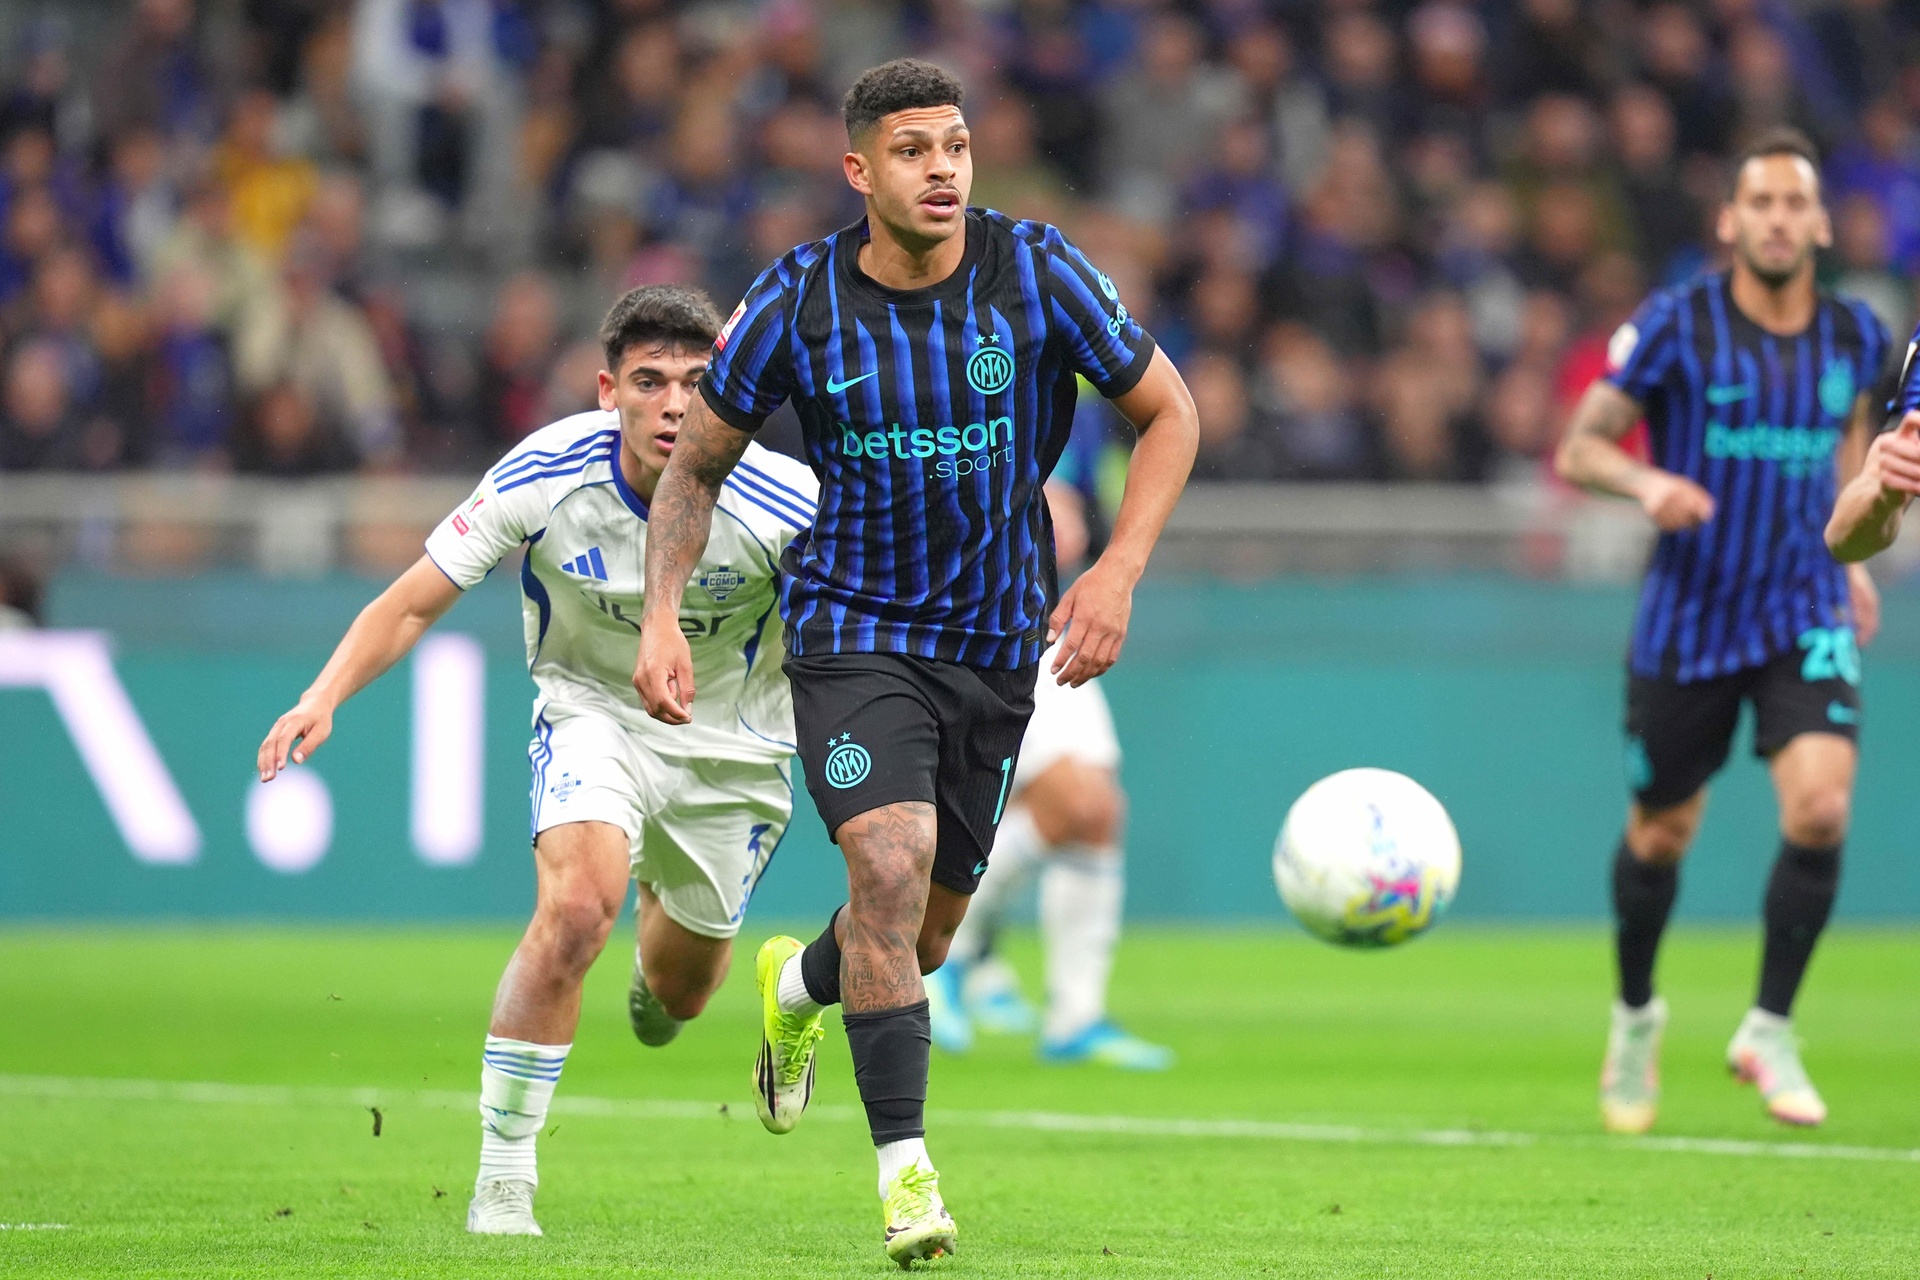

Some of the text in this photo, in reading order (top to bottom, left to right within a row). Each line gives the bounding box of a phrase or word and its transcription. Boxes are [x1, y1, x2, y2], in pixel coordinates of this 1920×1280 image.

[837, 416, 1013, 460] betsson
[929, 444, 1013, 481] .sport
[709, 577, 736, 587] COMO
